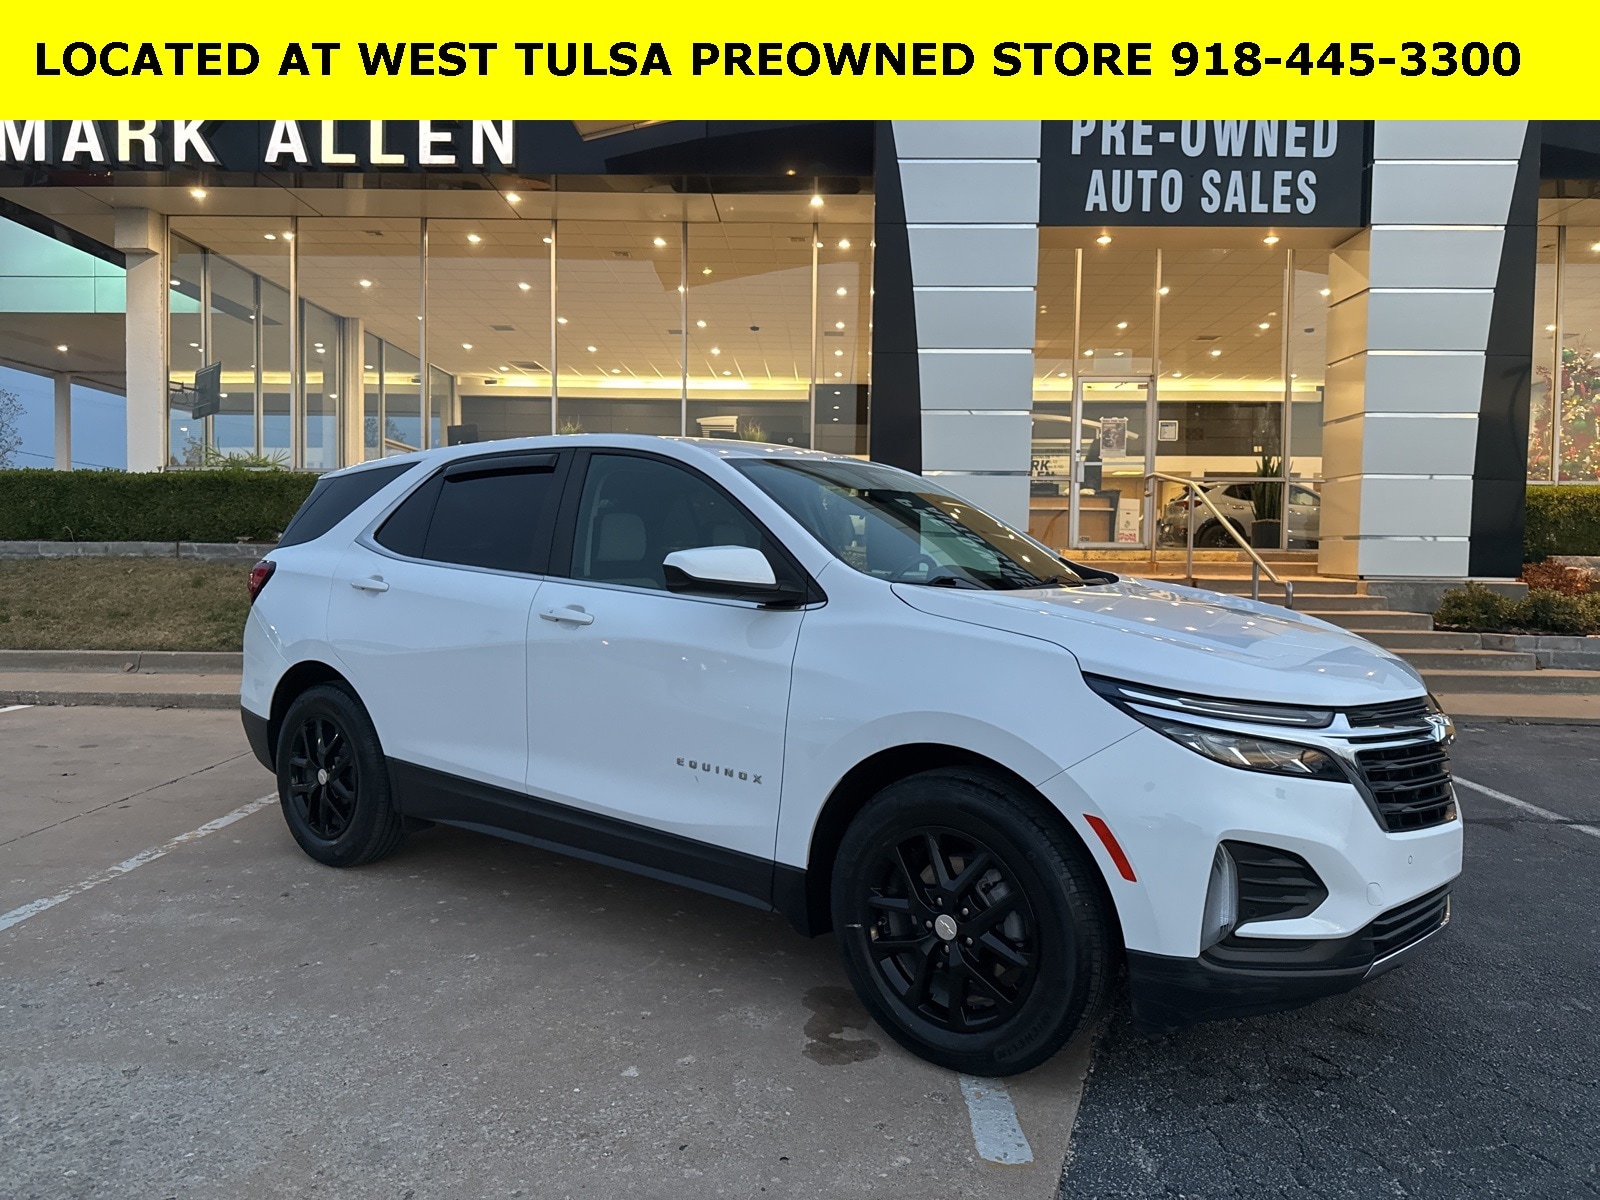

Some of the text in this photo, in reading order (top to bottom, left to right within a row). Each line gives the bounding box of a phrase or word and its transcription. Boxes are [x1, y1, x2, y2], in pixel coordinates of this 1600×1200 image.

[0, 120, 513, 164] MARK ALLEN
[1071, 120, 1338, 157] PRE-OWNED
[1085, 169, 1317, 214] AUTO SALES
[676, 757, 762, 785] EQUINOX
